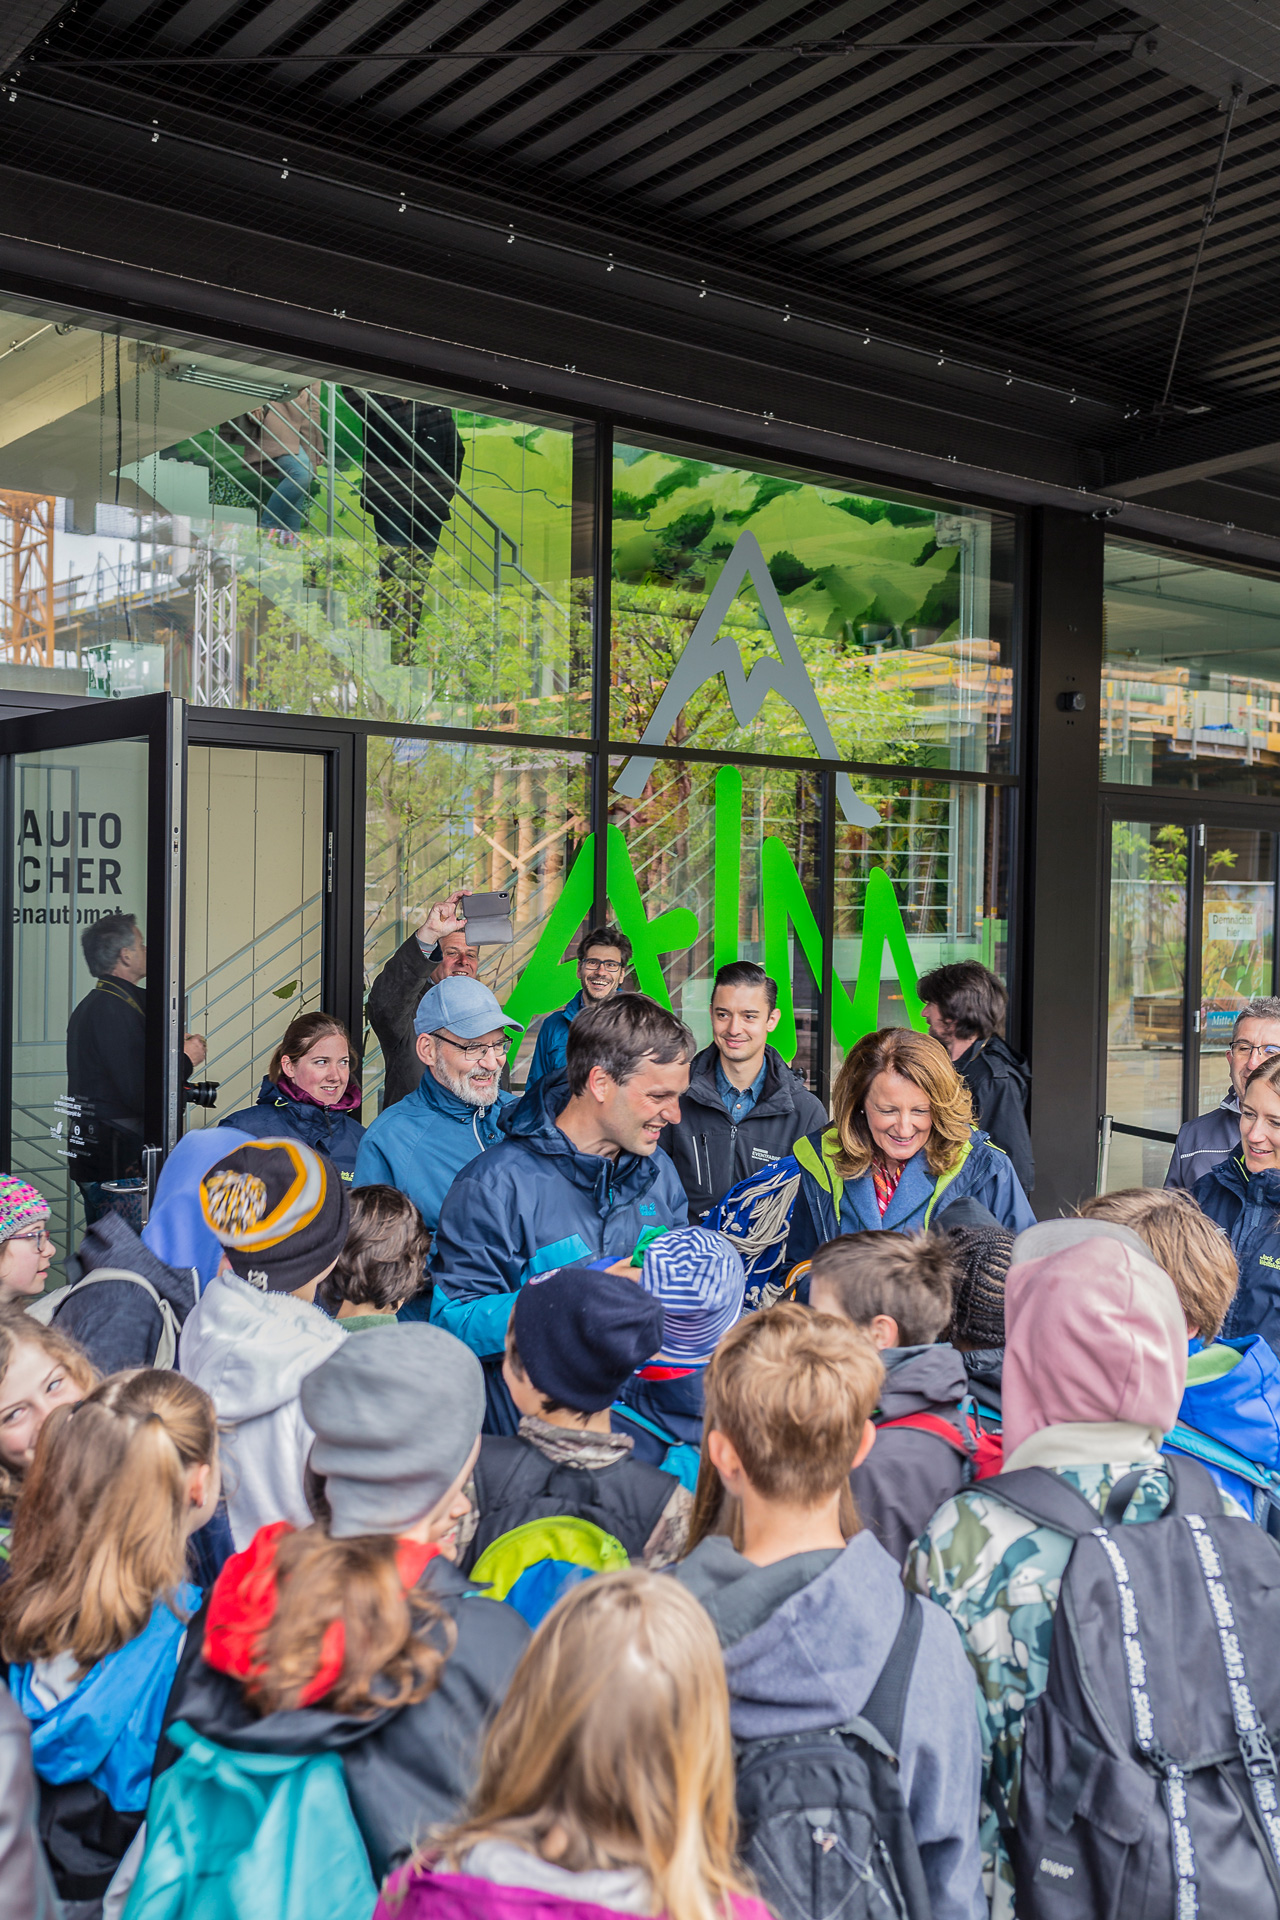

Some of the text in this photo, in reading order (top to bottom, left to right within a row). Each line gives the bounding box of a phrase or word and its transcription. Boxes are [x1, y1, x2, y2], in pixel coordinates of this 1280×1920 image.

[17, 809, 122, 849] AUTO
[18, 856, 122, 894] CHER
[1226, 926, 1240, 937] hier
